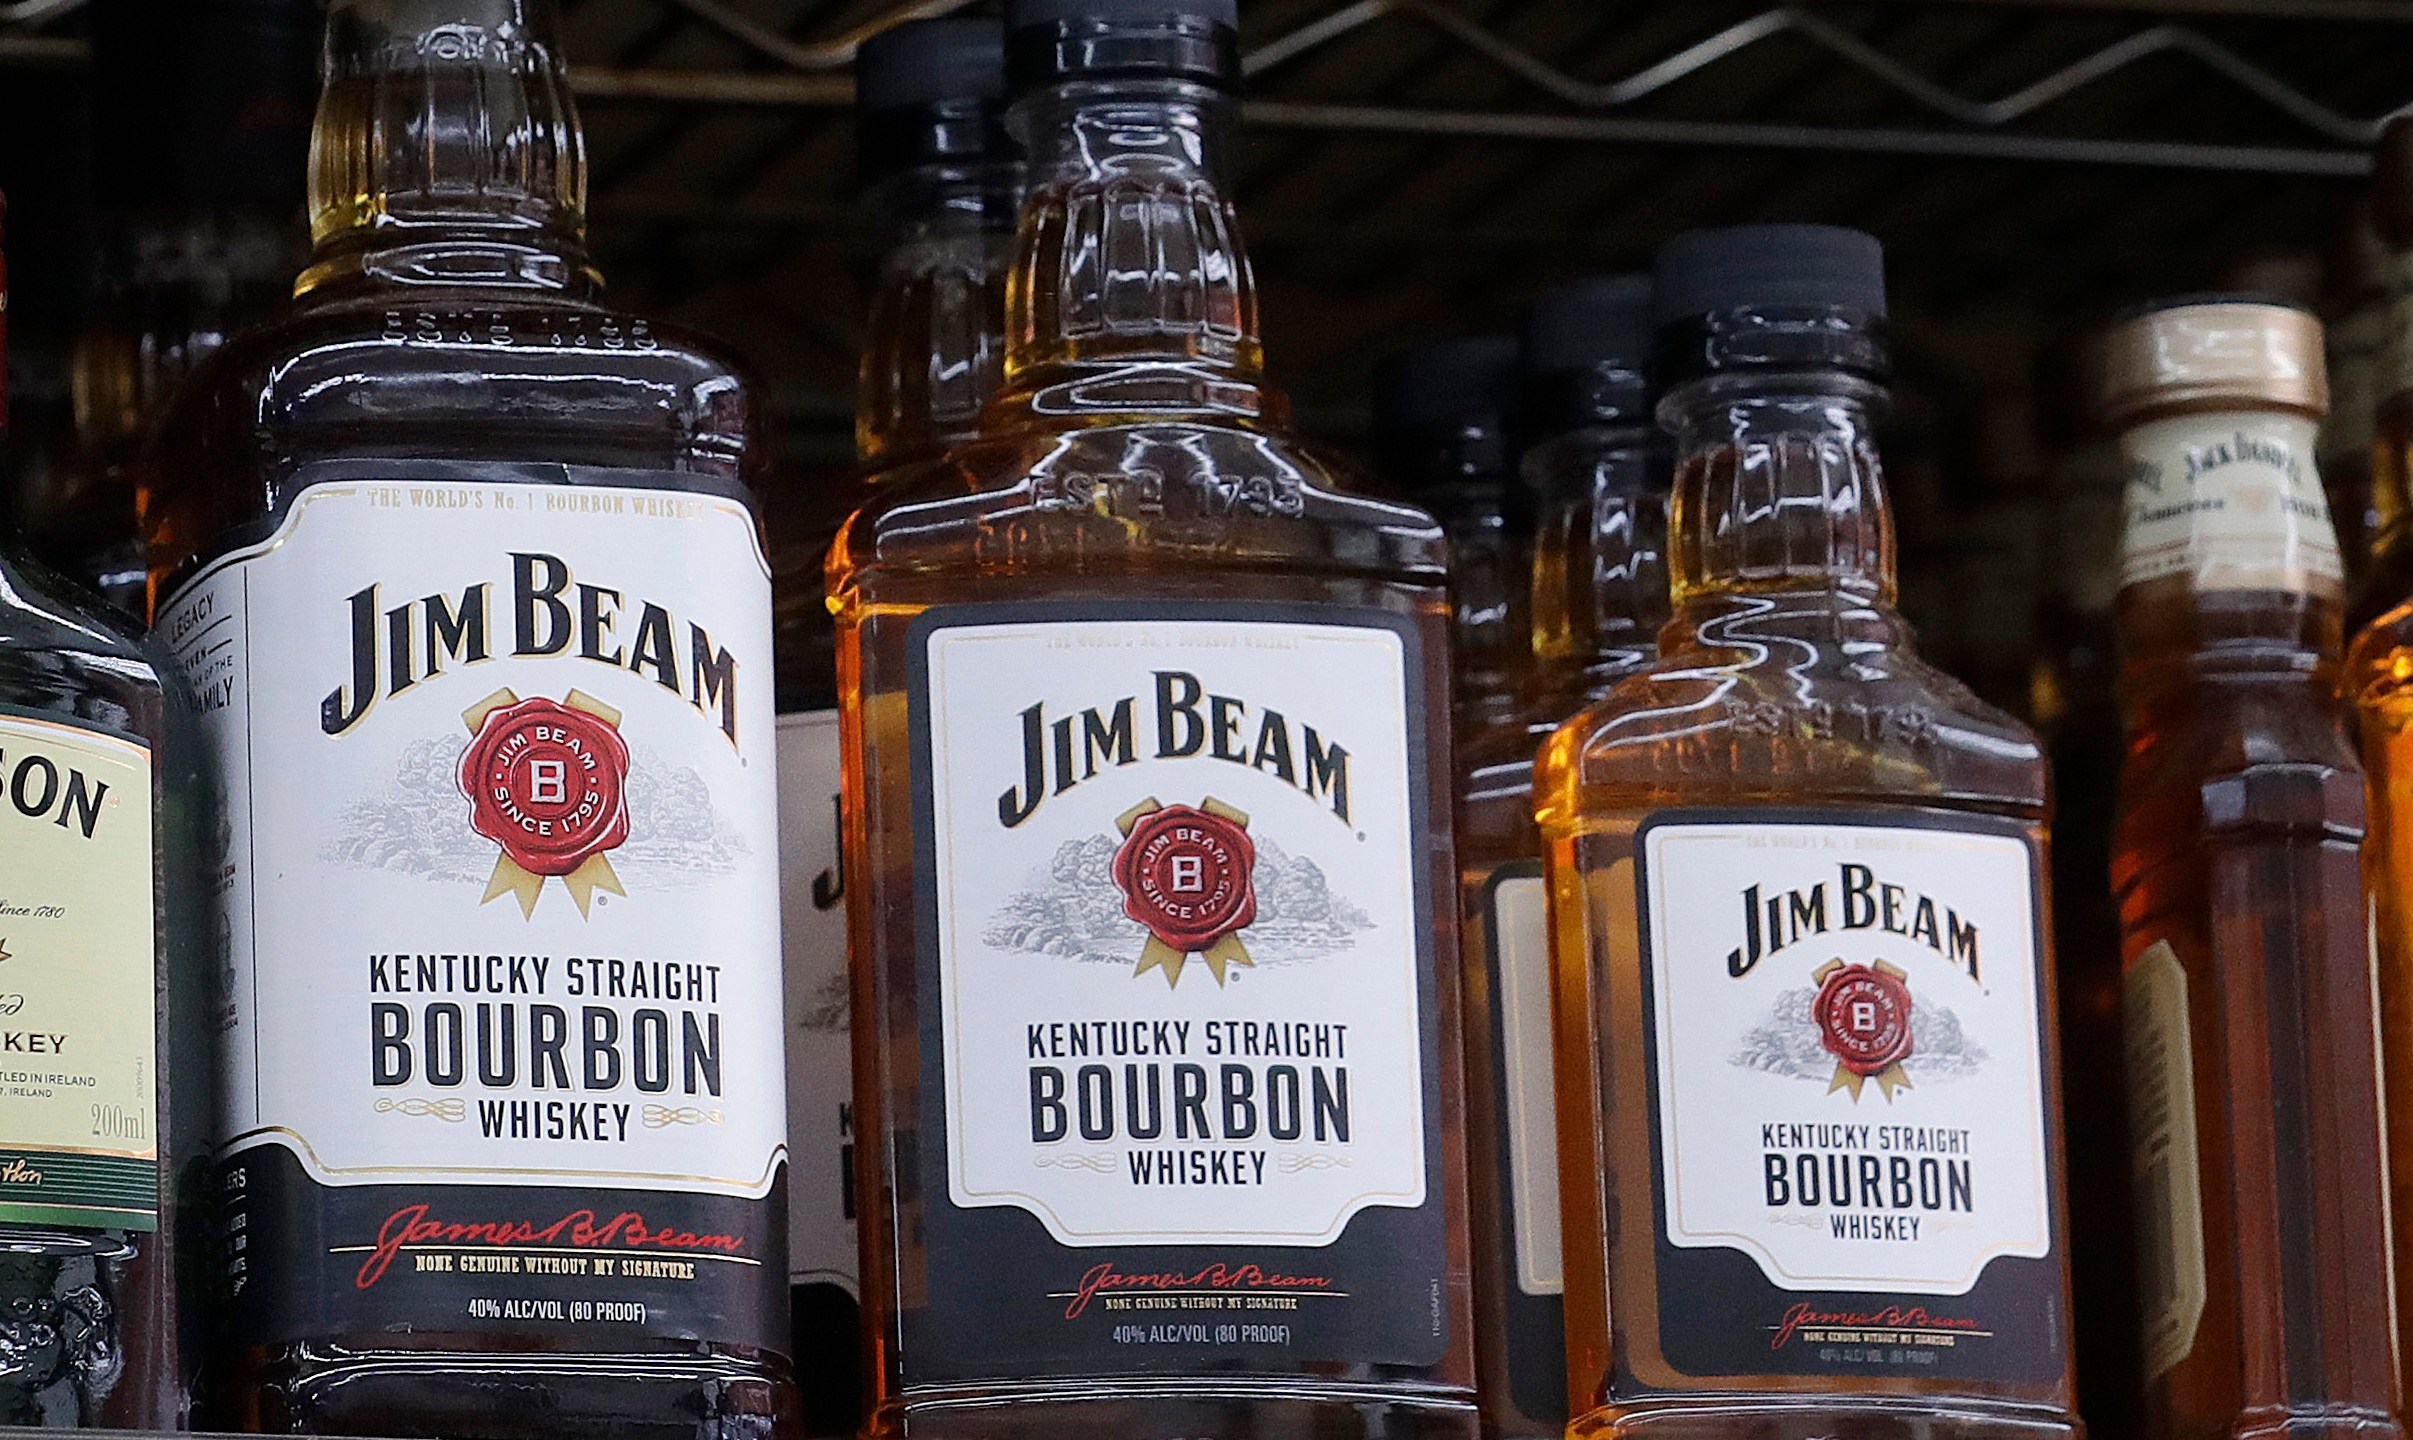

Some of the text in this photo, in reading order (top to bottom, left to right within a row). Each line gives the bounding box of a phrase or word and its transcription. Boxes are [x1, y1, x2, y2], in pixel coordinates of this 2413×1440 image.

[367, 489, 400, 507] THE
[410, 489, 483, 508] WORLD'S
[546, 493, 624, 514] BOURBON
[171, 591, 214, 643] LEGACY
[216, 655, 233, 672] THE
[321, 551, 741, 754] JIM BEAM
[498, 726, 597, 770] JIM BEAM
[998, 670, 1354, 829] JIM BEAM
[0, 748, 109, 839] ON
[530, 759, 566, 804] B
[494, 786, 600, 836] SINCE 1795
[1144, 828, 1229, 864] JIM BEAM
[1171, 856, 1204, 892] B
[33, 905, 66, 919] 1780
[1142, 879, 1231, 919] SINCE 1795
[1727, 862, 1983, 985] JIM BEAM
[369, 953, 721, 1005] KENTUCKY STRAIGHT
[1852, 1002, 1876, 1031] B
[371, 1002, 725, 1099] BOURBON
[1027, 1020, 1348, 1059] KENTUCKY STRAIGHT
[10, 1087, 52, 1098] IRELAND
[30, 1073, 43, 1084] IN
[45, 1075, 96, 1087] IRELAND
[91, 1103, 146, 1140] 200ml
[478, 1099, 630, 1142] WHISKEY
[1029, 1063, 1351, 1144] BOURBON
[1762, 1123, 1970, 1154] KENTUCKY STRAIGHT
[1128, 1150, 1266, 1186] WHISKEY
[1764, 1153, 1973, 1213] BOURBON
[1830, 1214, 1920, 1241] WHISKEY
[356, 1205, 536, 1290] James
[598, 1210, 744, 1250] Beam
[415, 1254, 696, 1280] NONE GENUINE WITHOUT MY SIGNATURE
[468, 1298, 647, 1325] 40% ALC/VOL (80 PROOF)
[1065, 1263, 1192, 1321] James
[1228, 1264, 1334, 1288] Beam
[1105, 1297, 1132, 1311] NONE
[1113, 1325, 1291, 1347] 40% ALC/VOL (80 PROOF)
